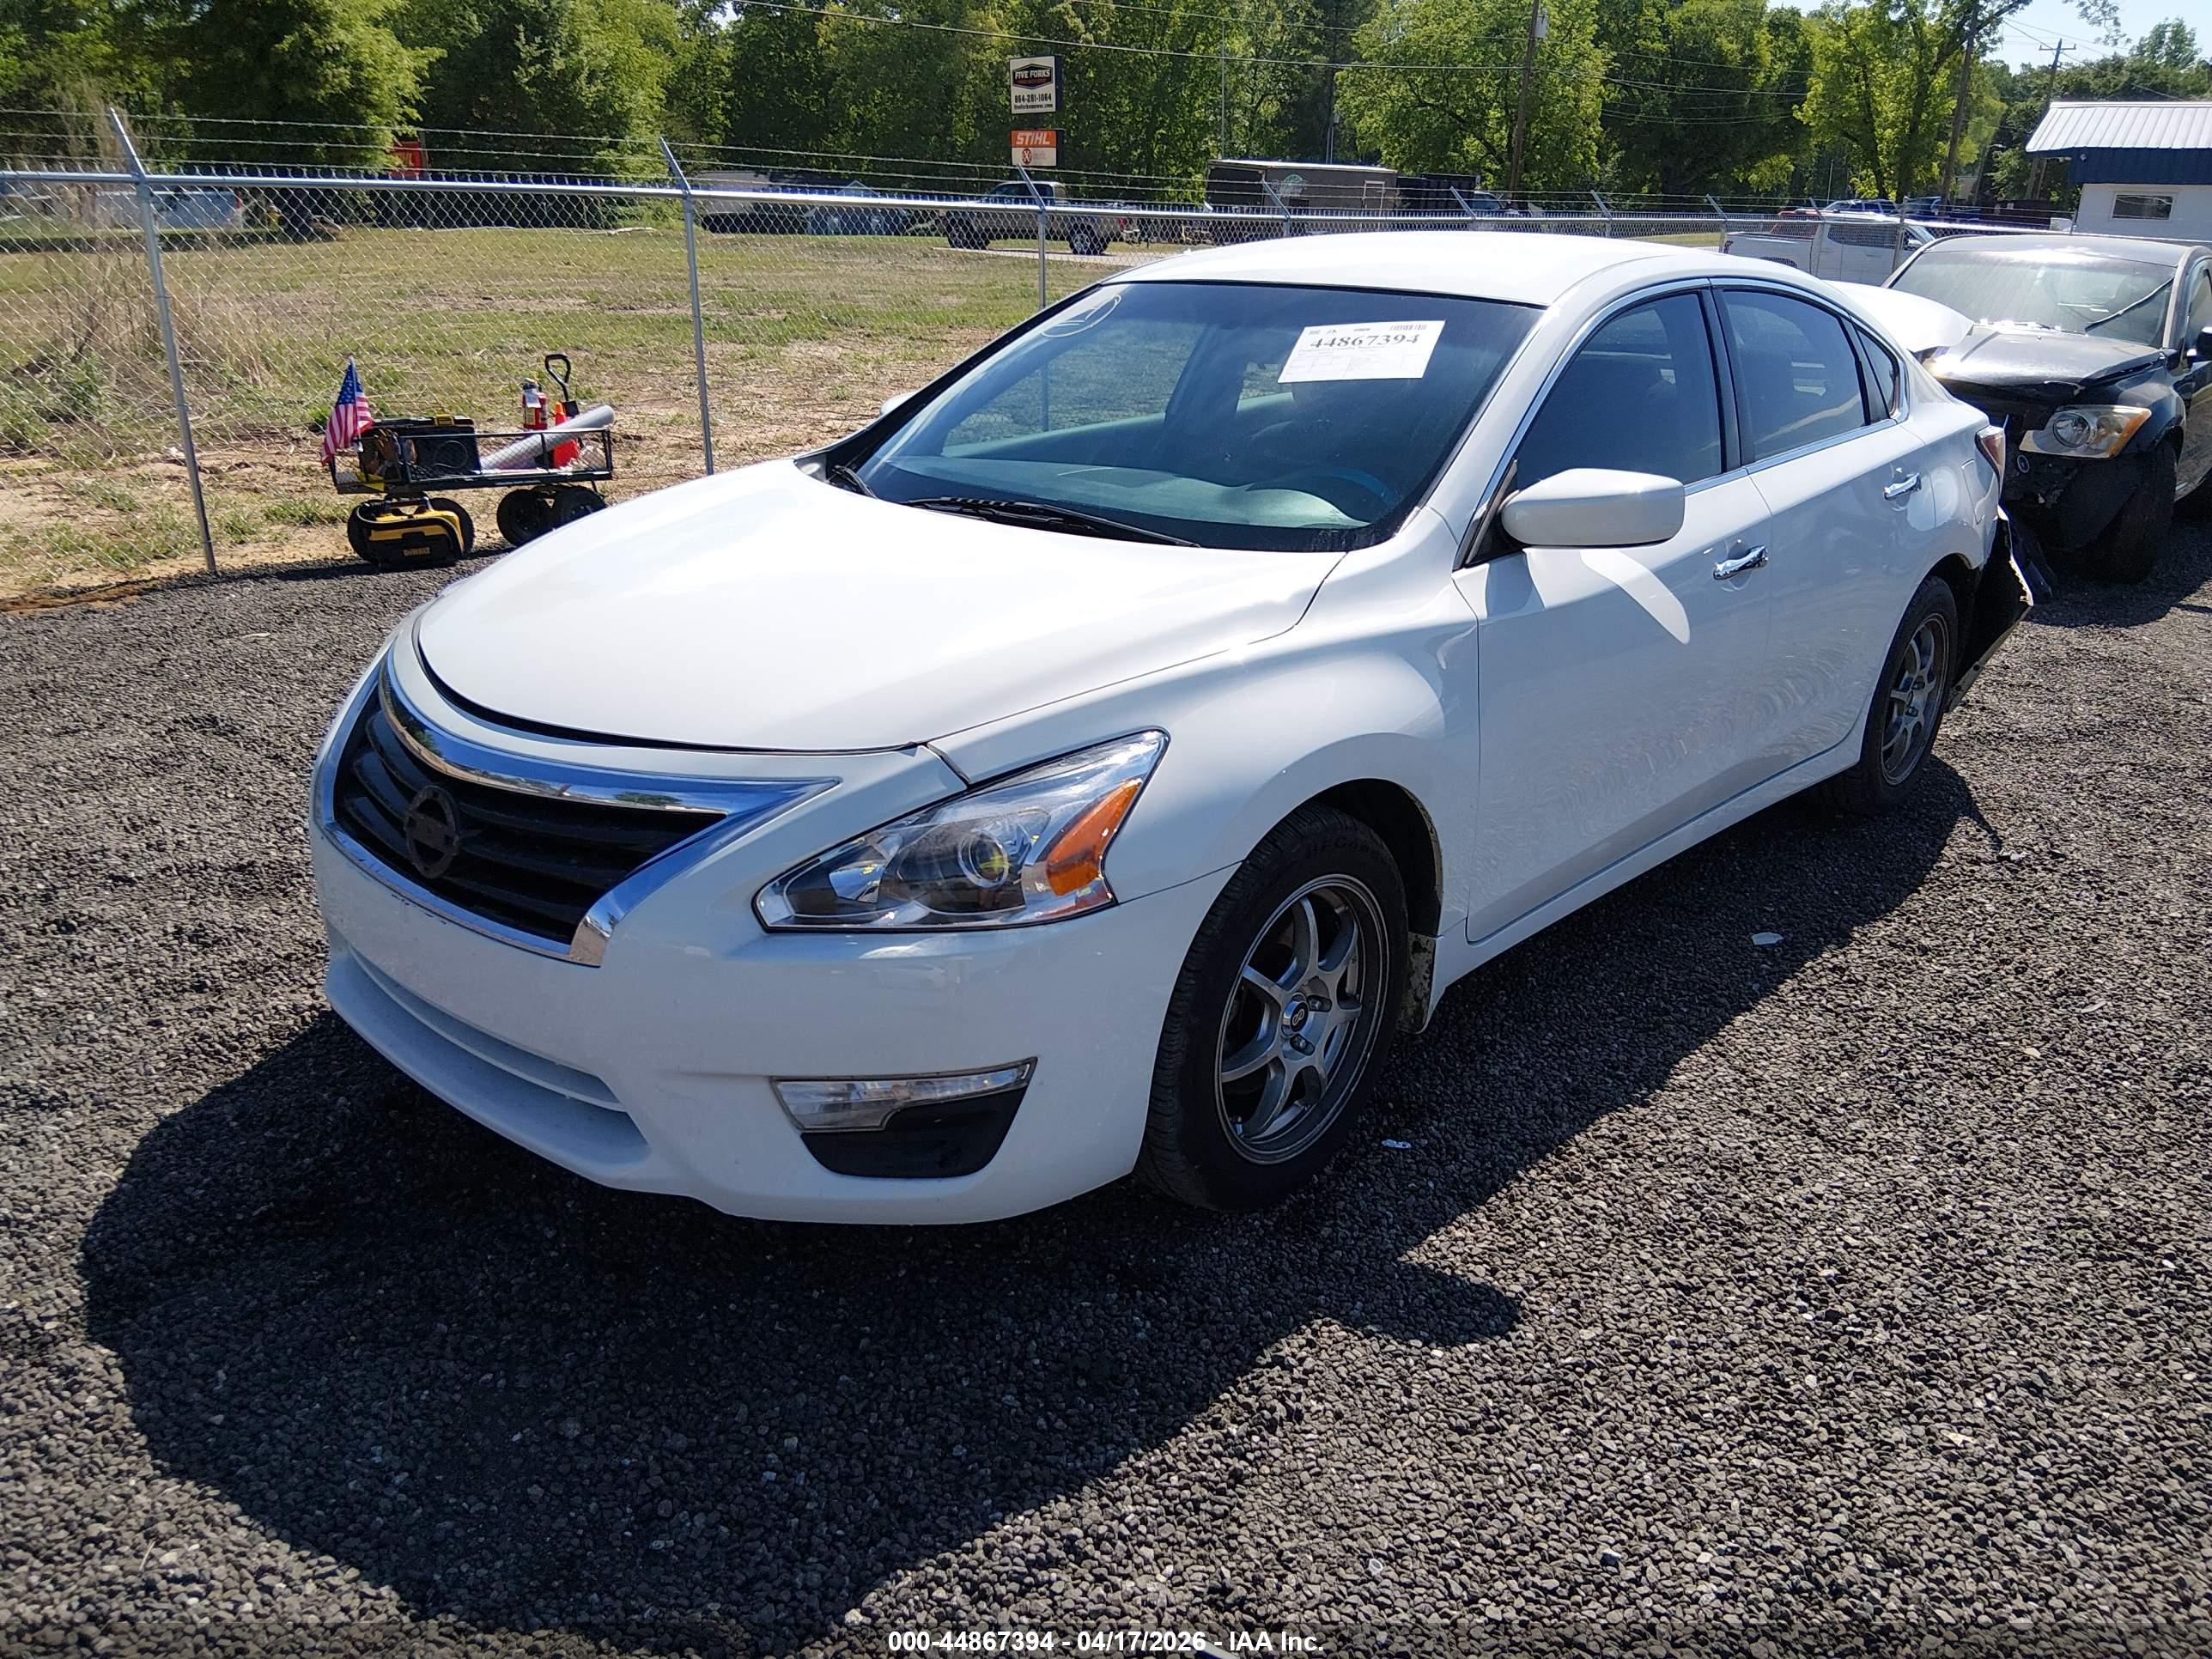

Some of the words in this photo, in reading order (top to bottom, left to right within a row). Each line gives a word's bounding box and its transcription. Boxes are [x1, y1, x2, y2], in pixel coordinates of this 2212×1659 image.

[1015, 71, 1029, 80] FIVE
[1030, 70, 1051, 78] FORKS
[1016, 132, 1050, 145] STIHL
[1310, 333, 1420, 349] 44867394
